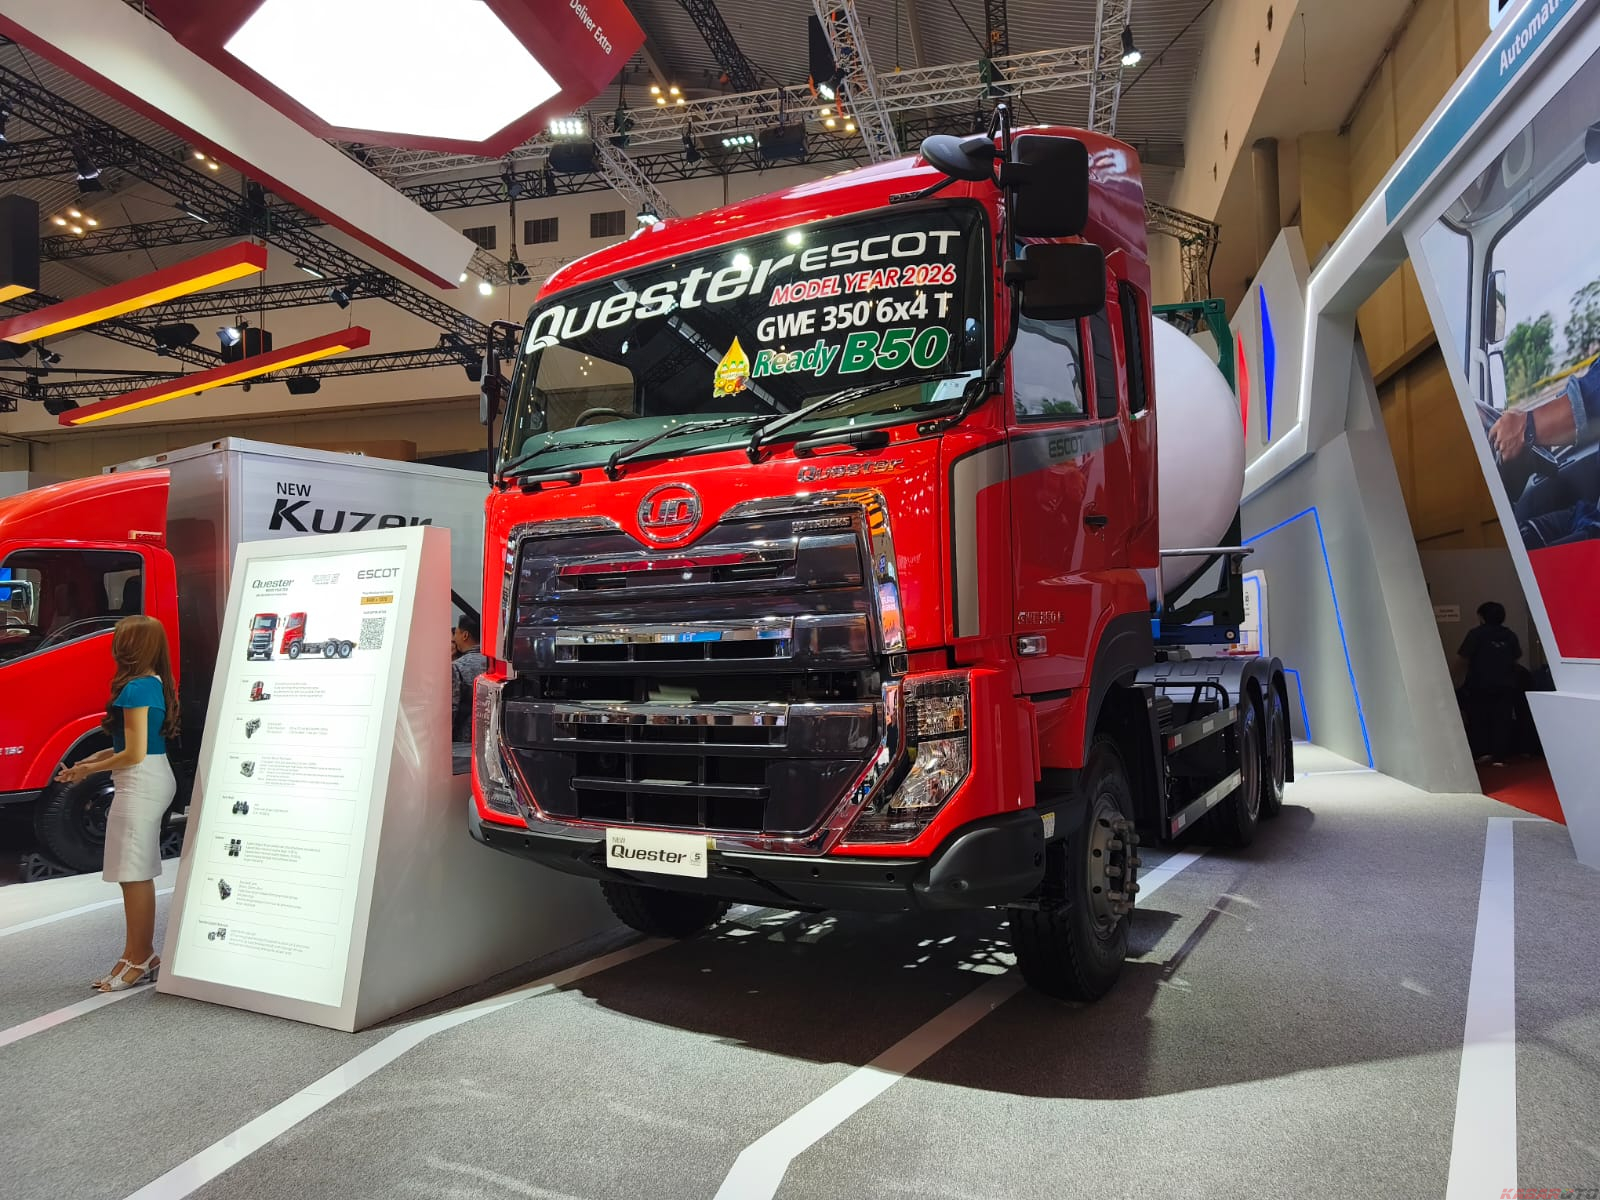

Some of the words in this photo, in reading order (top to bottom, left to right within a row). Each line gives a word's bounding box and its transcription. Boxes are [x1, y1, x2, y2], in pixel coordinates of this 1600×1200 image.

[569, 0, 596, 32] Deliver
[593, 27, 613, 55] Extra
[525, 254, 795, 355] Quester
[799, 230, 961, 271] ESCOT
[769, 278, 842, 307] MODEL
[844, 270, 899, 293] YEAR
[902, 263, 957, 288] 2026
[756, 311, 816, 341] GWE
[820, 300, 871, 333] 350
[876, 293, 929, 323] 6x4
[934, 292, 953, 317] T
[753, 341, 840, 378] Ready
[838, 327, 950, 374] B50
[1048, 437, 1084, 458] ESCOT
[797, 459, 904, 483] Quester
[276, 482, 311, 497] NEW
[643, 498, 696, 528] UD
[807, 516, 851, 530] TRUCKS
[252, 579, 295, 589] Quester
[357, 567, 400, 580] ESCOT
[611, 844, 687, 864] Quester
